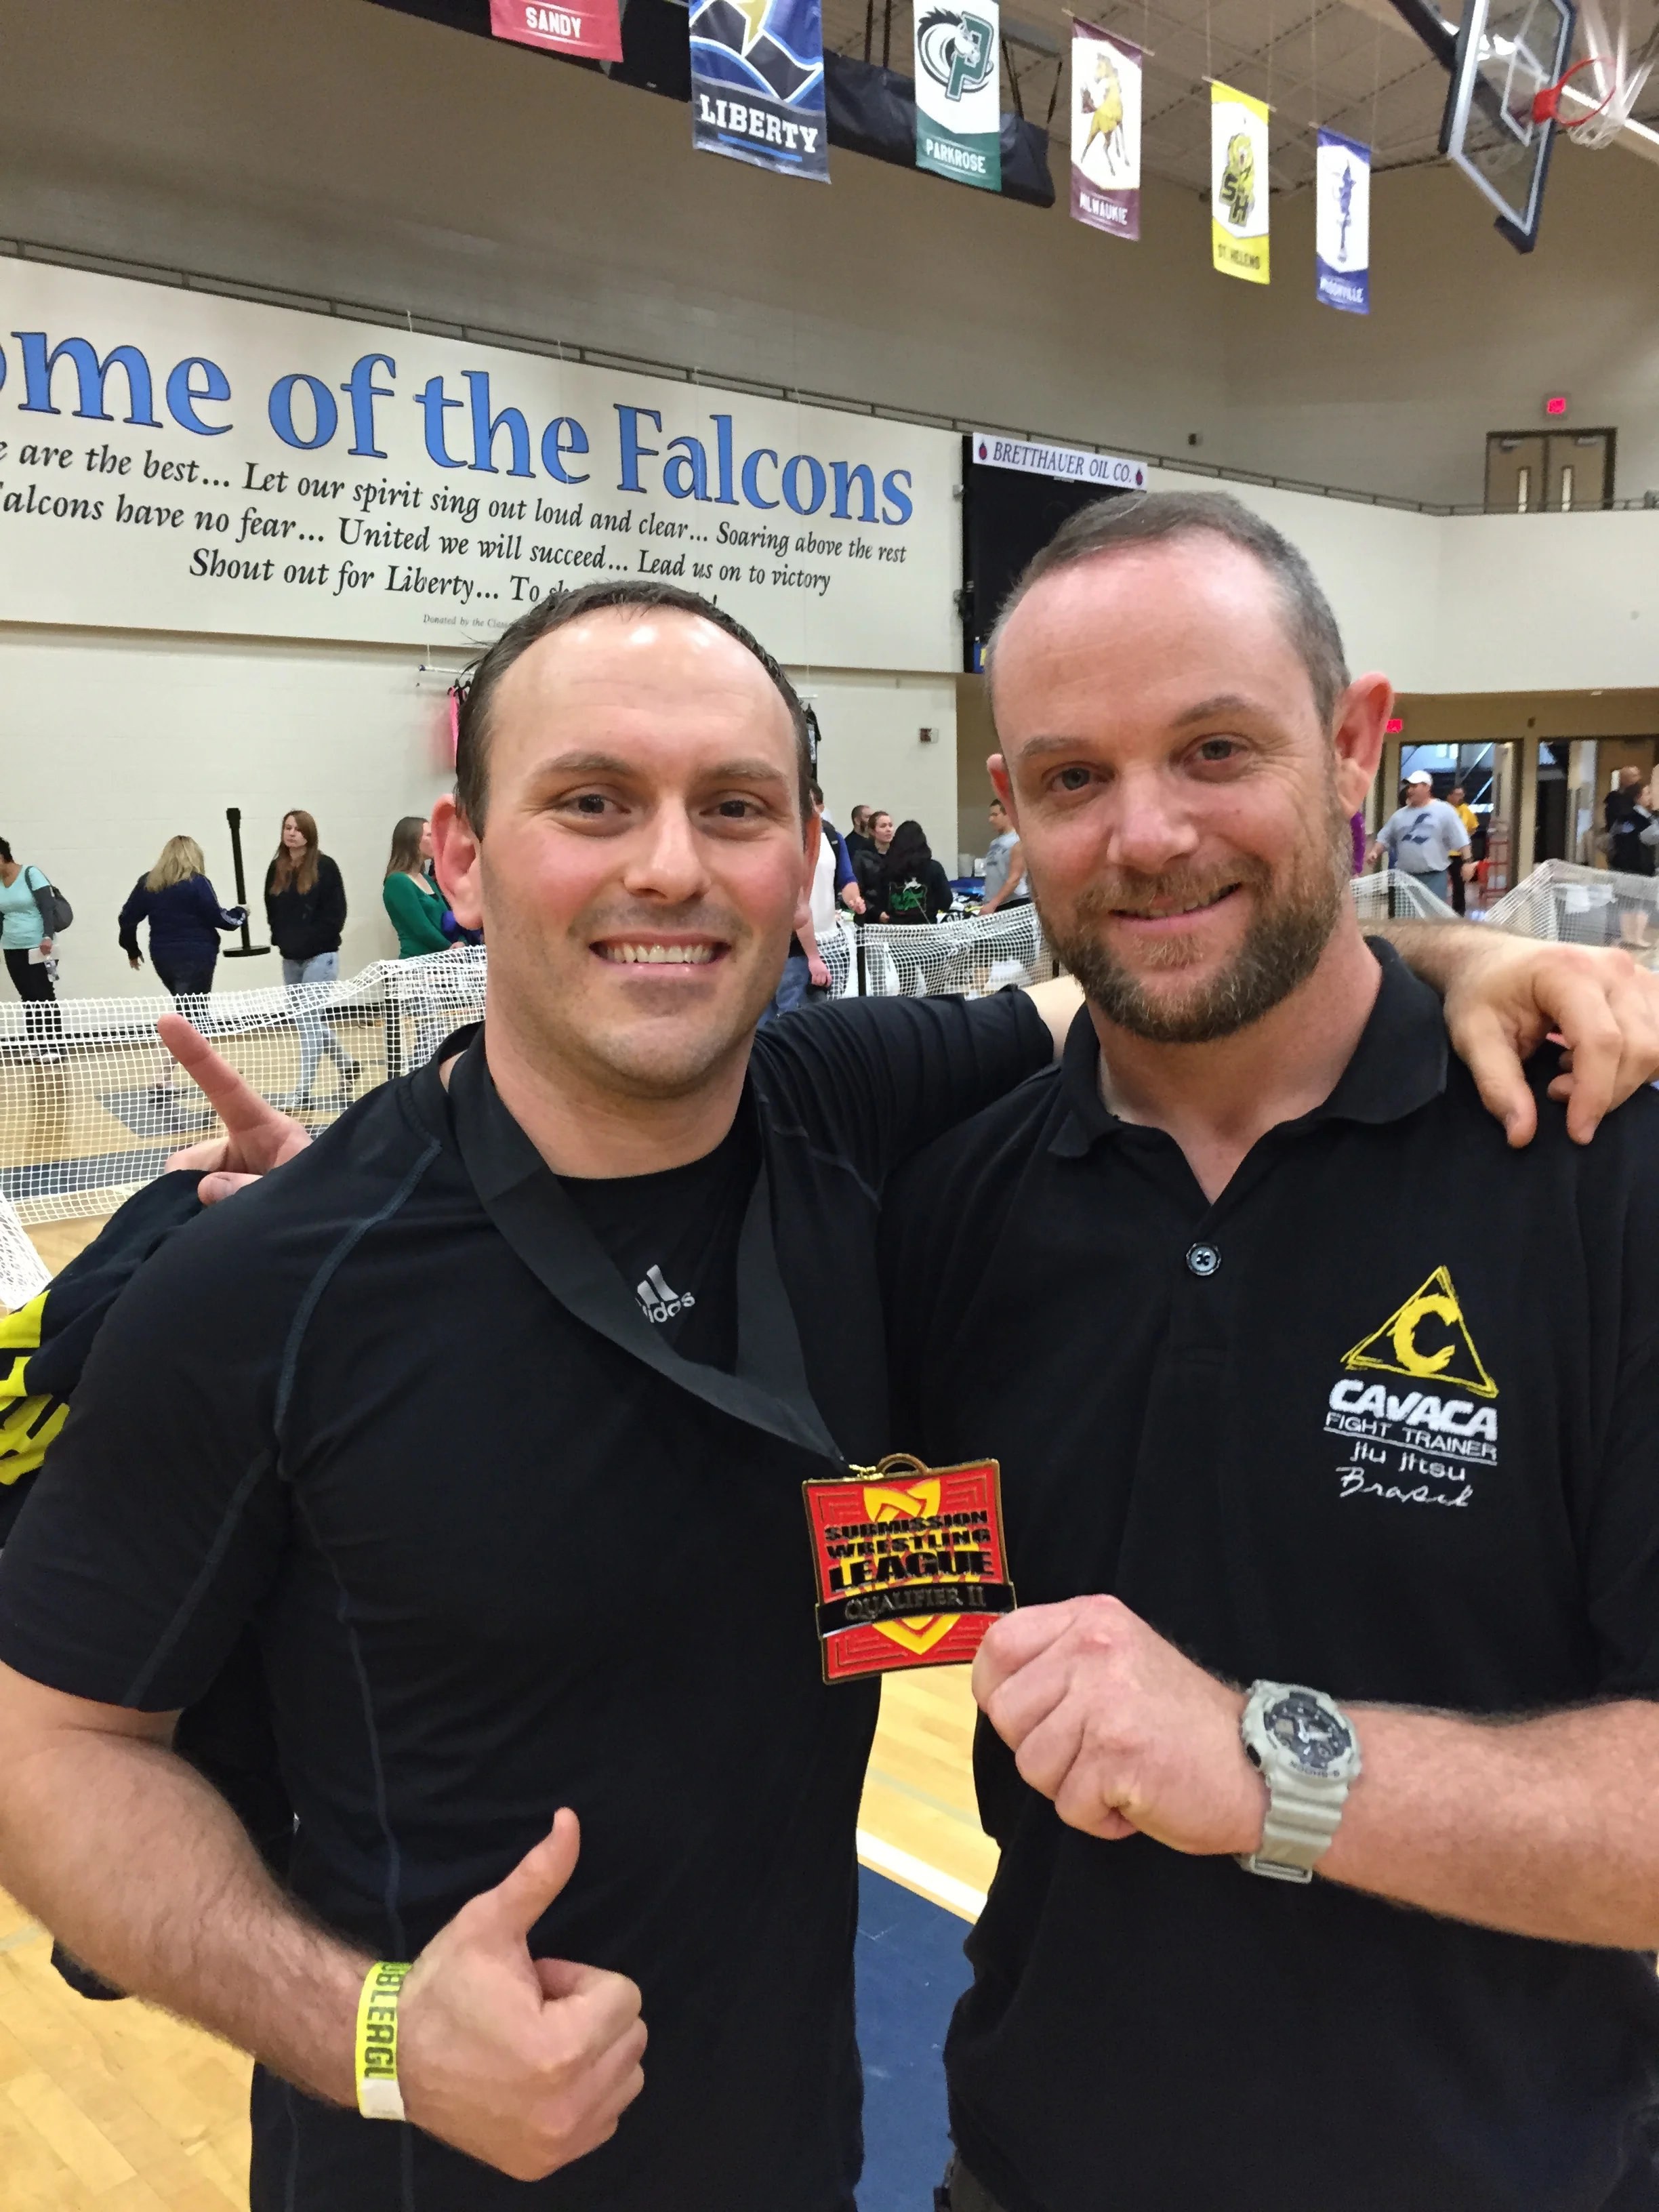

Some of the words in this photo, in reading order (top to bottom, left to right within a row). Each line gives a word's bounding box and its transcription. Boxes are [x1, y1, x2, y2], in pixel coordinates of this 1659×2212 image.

[525, 6, 582, 39] SANDY
[699, 94, 819, 154] LIBERTY
[926, 138, 987, 174] PARKROSE
[1079, 191, 1128, 226] MILWAUKIE
[267, 352, 397, 459] of
[413, 370, 590, 485] the
[613, 403, 914, 526] Falcons
[993, 441, 1084, 476] BRETTHAUER
[1089, 458, 1110, 479] OIL
[1113, 463, 1132, 483] CO.
[18, 444, 74, 470] are
[84, 443, 132, 476] the
[242, 461, 289, 494] Let
[297, 476, 346, 499] our
[352, 477, 422, 514] spirit
[430, 485, 481, 524] sing
[488, 499, 528, 520] out
[534, 497, 583, 528] loud
[589, 508, 632, 533] and
[716, 520, 790, 558] Soaring
[794, 530, 843, 557] above
[848, 537, 872, 560] the
[878, 546, 907, 564] rest
[0, 480, 105, 521] alcons
[115, 493, 185, 529] have
[194, 510, 230, 533] no
[338, 516, 430, 553] United
[438, 535, 470, 556] we
[476, 533, 523, 561] will
[636, 548, 687, 577] Lead
[692, 561, 714, 579] us
[718, 565, 741, 582] on
[748, 565, 766, 586] to
[771, 562, 832, 597] victory
[188, 547, 276, 582] Shout
[283, 562, 330, 586] out
[331, 559, 375, 597] for
[509, 574, 540, 603] To
[423, 613, 457, 626] Donated
[459, 616, 470, 627] by
[472, 617, 485, 628] the
[1393, 1292, 1461, 1376] C
[1328, 1378, 1498, 1441] CAVACA
[1325, 1411, 1392, 1437] FIGHT
[1401, 1427, 1498, 1461] TRAINER
[824, 1510, 988, 1542] SUBMISSION
[826, 1528, 991, 1559] WRESTLING
[829, 1551, 994, 1593] LEAGUE
[845, 1588, 964, 1620] QUALIFIER
[966, 1586, 987, 1608] II
